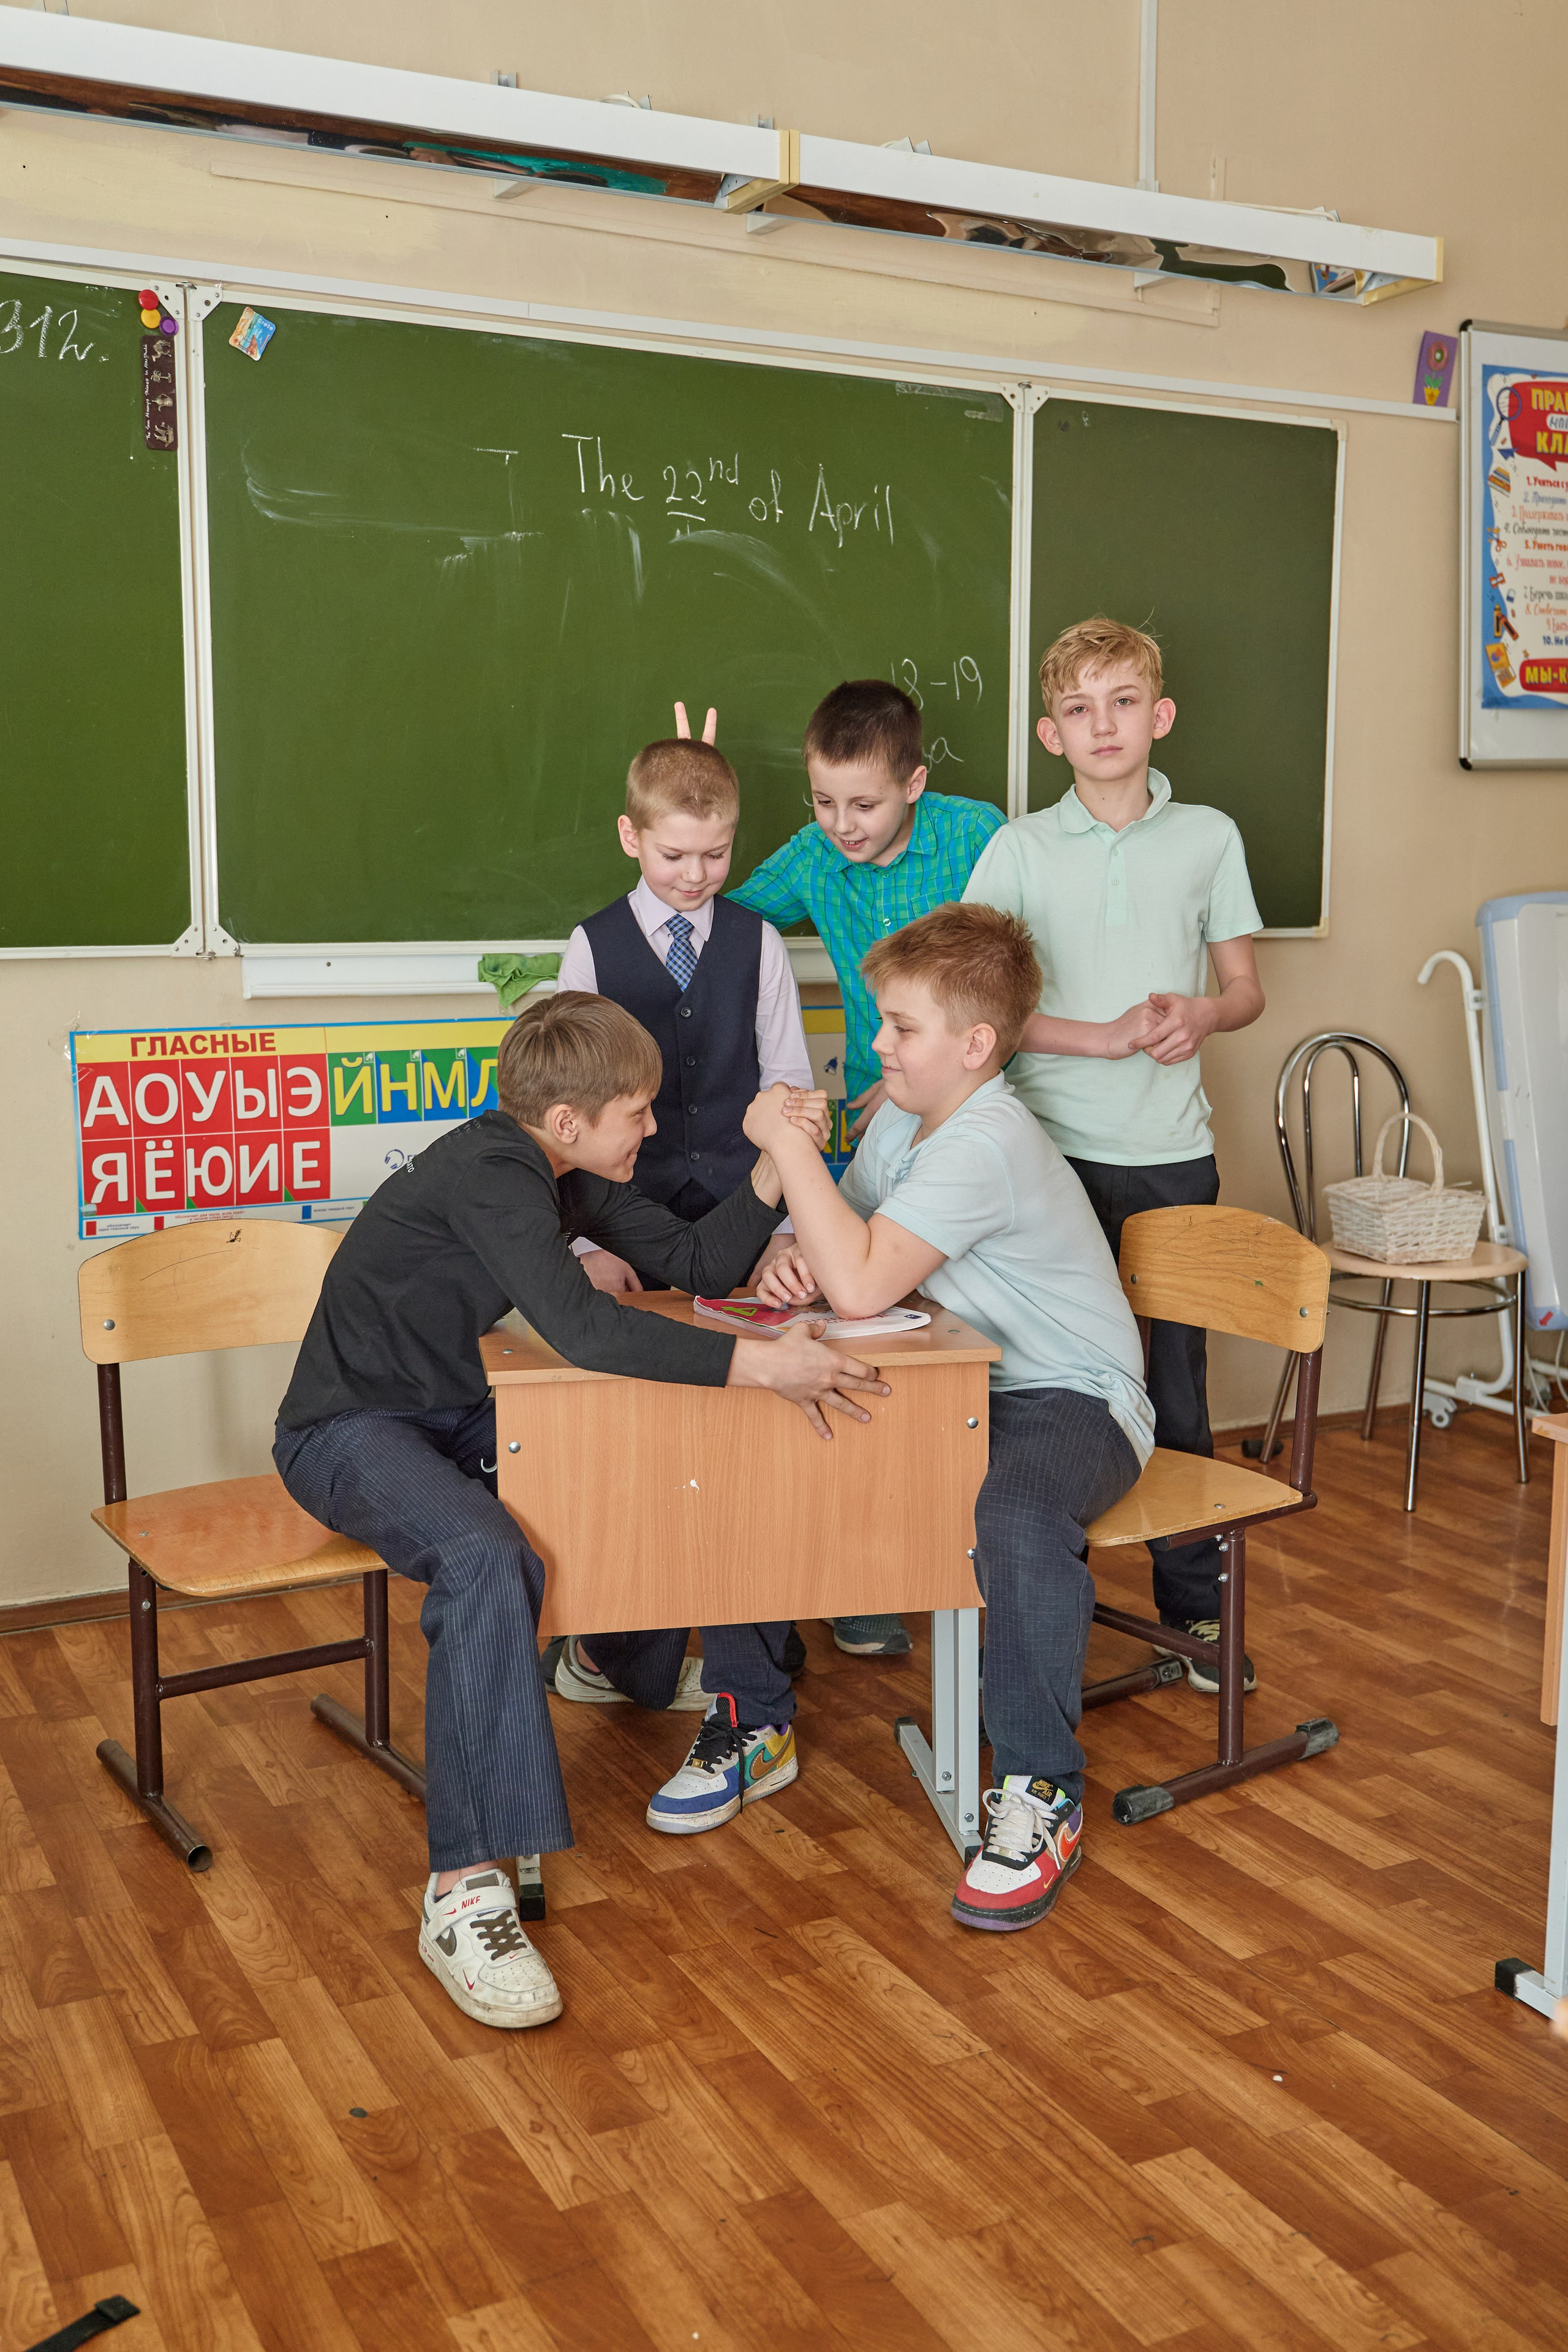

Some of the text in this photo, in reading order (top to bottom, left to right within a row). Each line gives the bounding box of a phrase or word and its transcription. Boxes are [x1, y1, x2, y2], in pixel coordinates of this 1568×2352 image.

[561, 434, 644, 501] The
[748, 469, 784, 523] of
[809, 464, 894, 547] April
[1525, 665, 1568, 685] МЫ-К
[130, 1032, 276, 1057] ГЛАСНЫЕ
